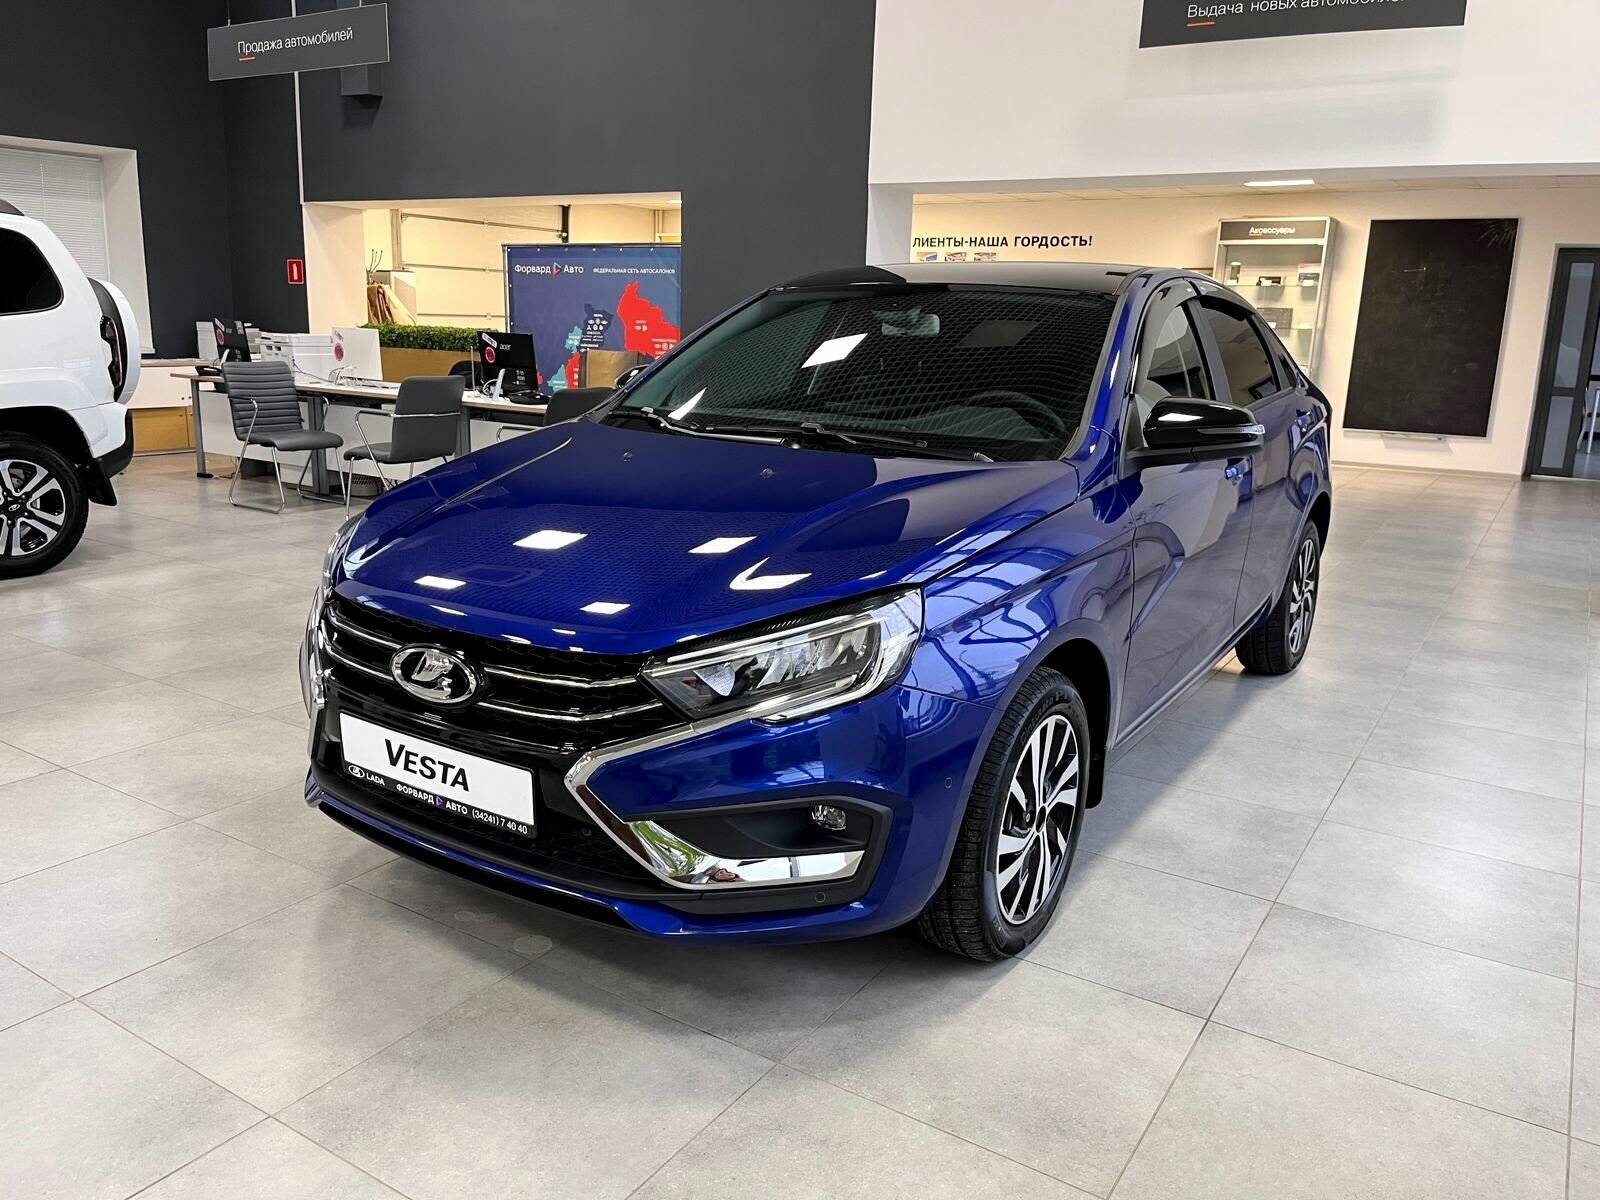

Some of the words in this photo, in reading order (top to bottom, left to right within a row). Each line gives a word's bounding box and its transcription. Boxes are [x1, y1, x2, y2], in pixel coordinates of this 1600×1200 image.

[1187, 3, 1243, 18] Выдача
[1250, 0, 1297, 12] новых
[238, 38, 283, 55] Продажа
[285, 27, 353, 48] автомобилей
[1248, 226, 1296, 236] Аксессуары
[912, 236, 1009, 248] ЛИЕНТЫ-НАША
[1013, 235, 1093, 249] ГОРДОСТЬ!
[514, 264, 551, 275] Форвард
[563, 264, 584, 274] Авто
[384, 738, 470, 792] VESTA
[366, 772, 386, 786] LADA
[396, 783, 435, 805] ФОРВАРД
[445, 800, 468, 815] АВТО
[472, 808, 499, 826] (34241)
[500, 818, 506, 827] 7
[506, 821, 517, 831] 40
[517, 825, 528, 835] 40
